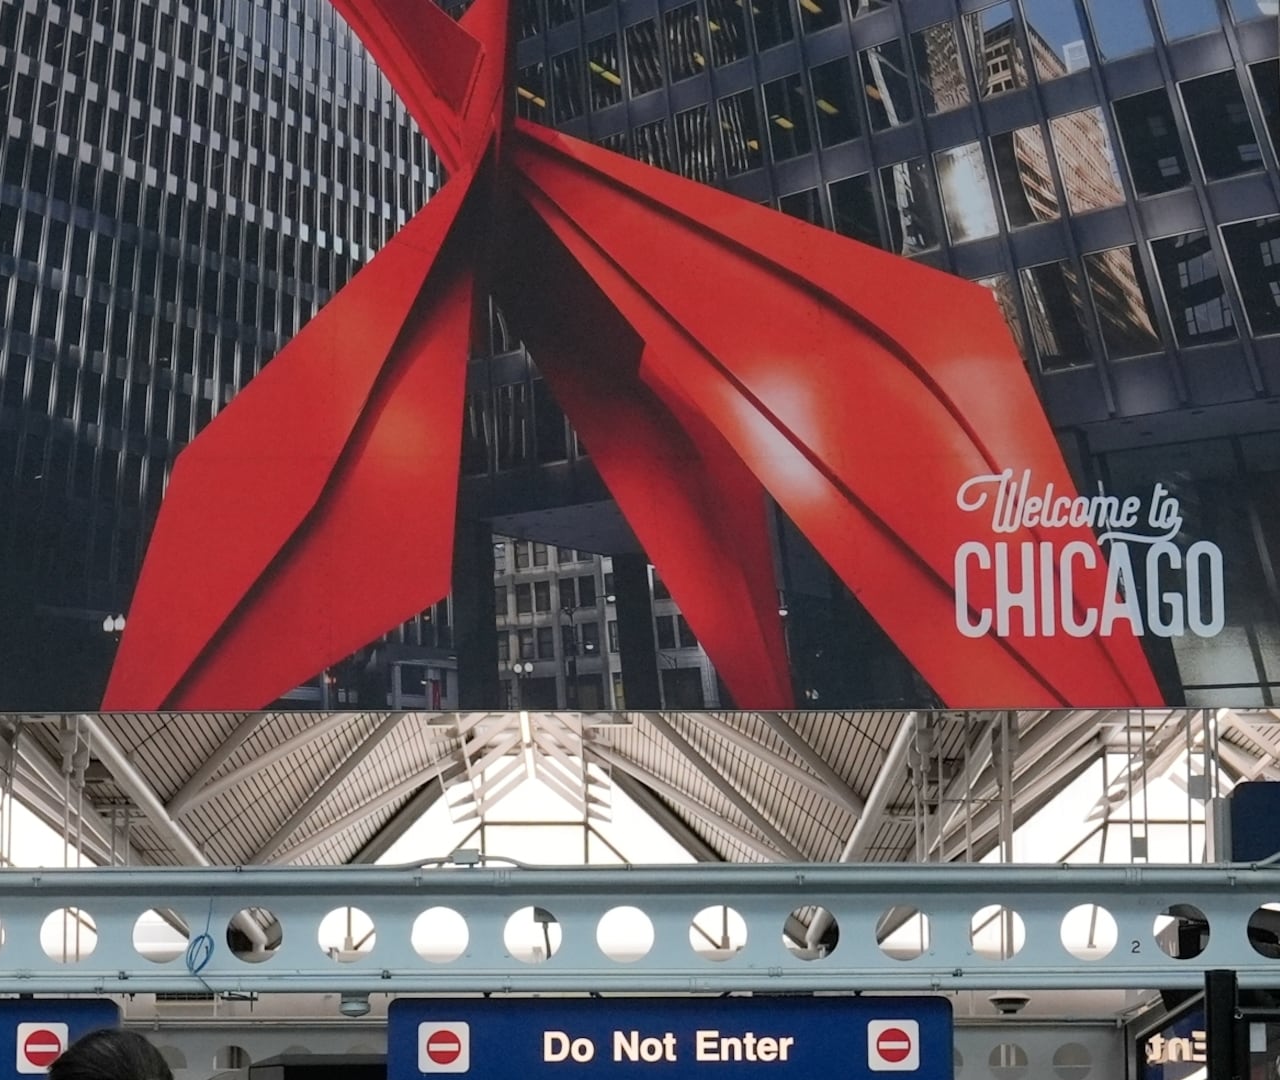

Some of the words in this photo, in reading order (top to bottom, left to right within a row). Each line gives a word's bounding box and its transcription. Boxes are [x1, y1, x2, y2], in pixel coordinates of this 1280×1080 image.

[956, 468, 1140, 534] Welcome
[954, 540, 1225, 638] CHICAGO
[1131, 940, 1141, 954] 2
[543, 1031, 595, 1063] Do
[613, 1031, 677, 1062] Not
[696, 1031, 794, 1062] Enter
